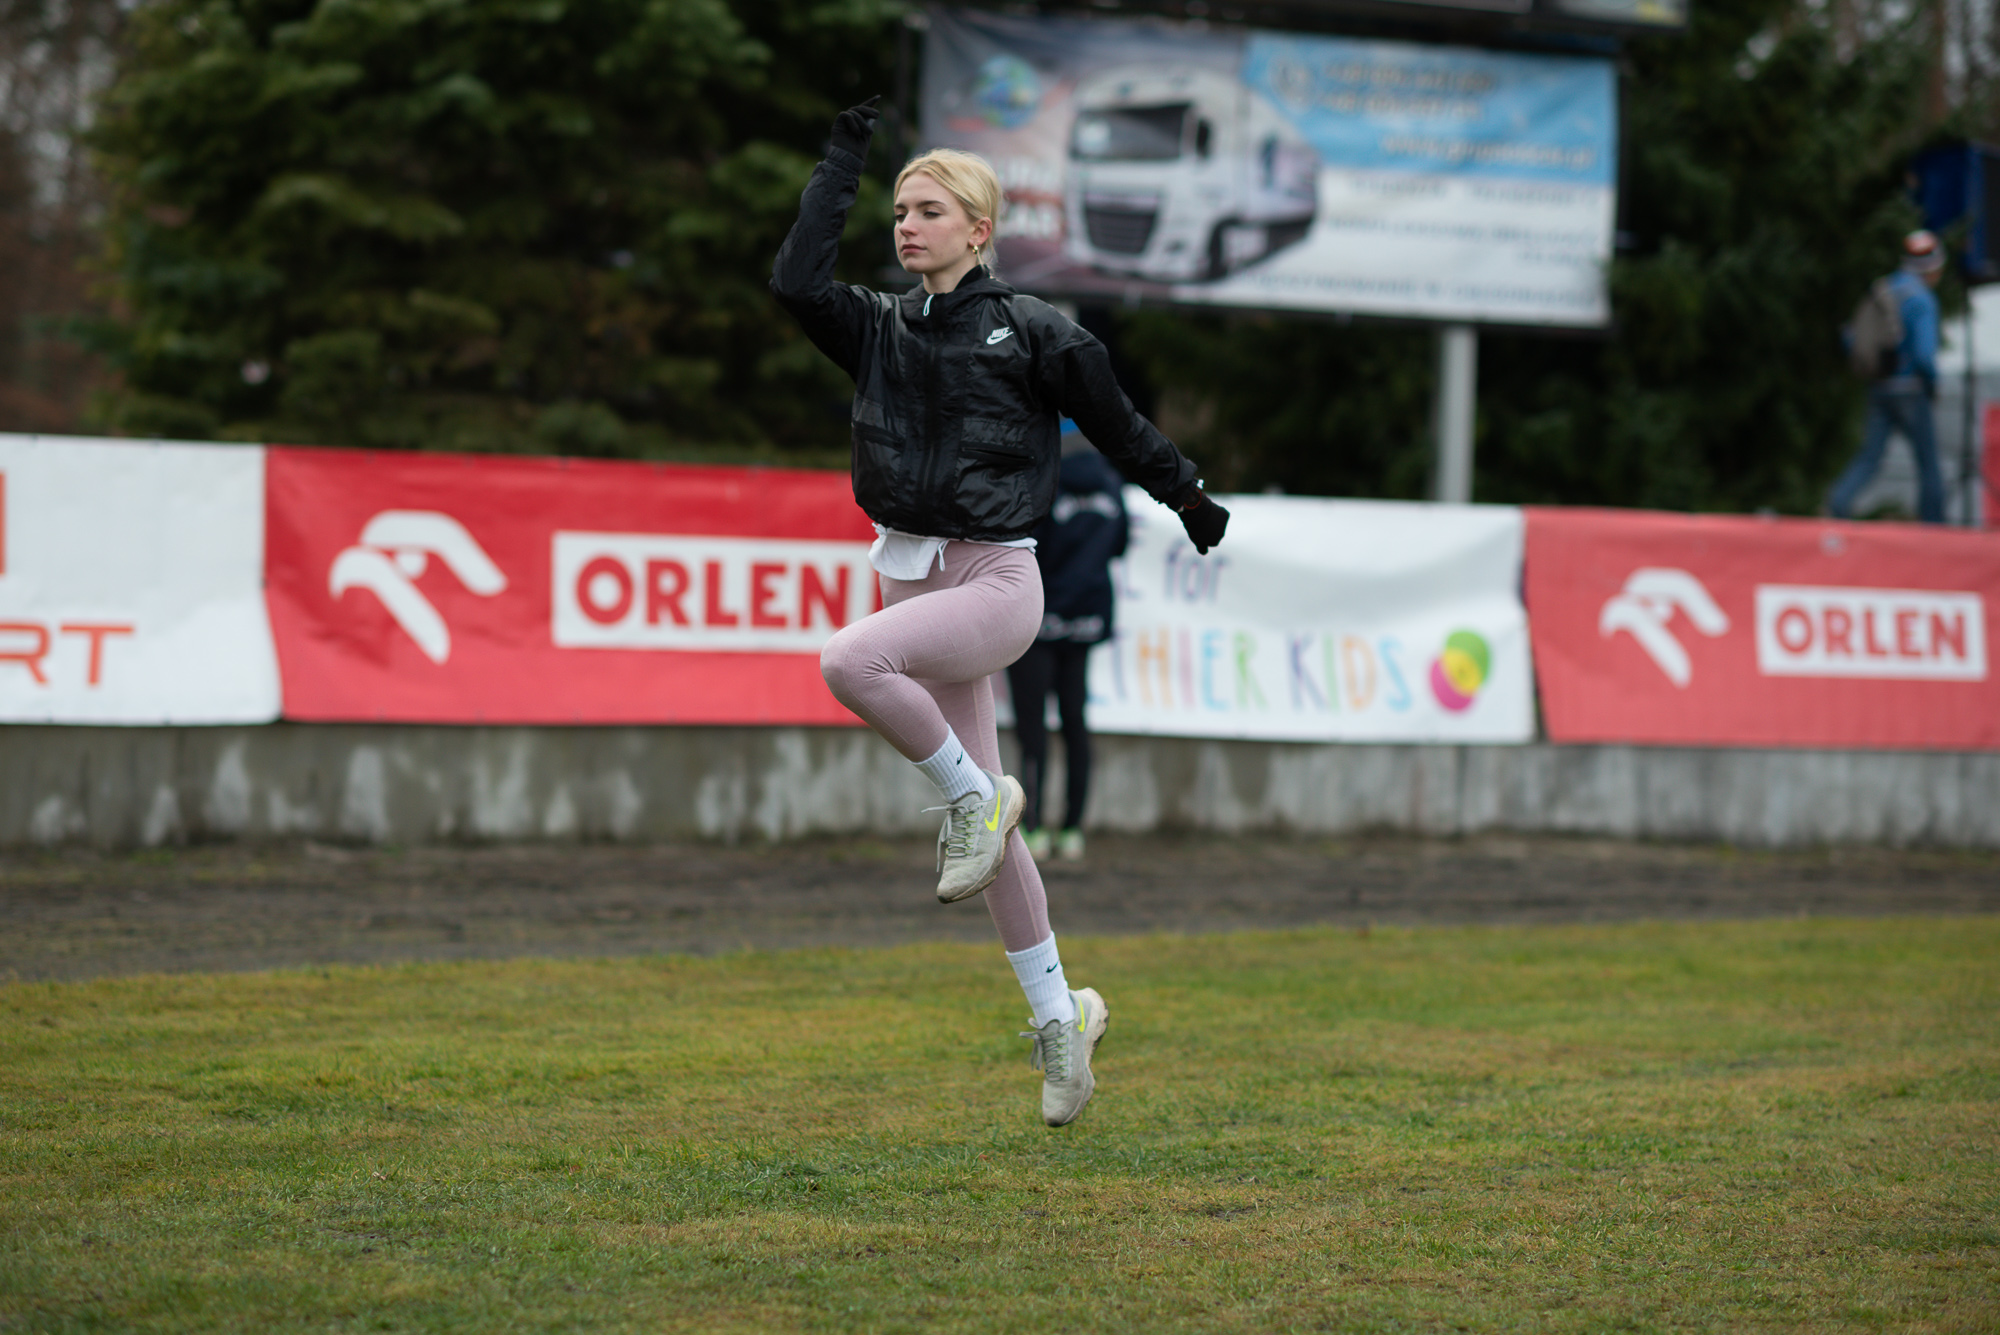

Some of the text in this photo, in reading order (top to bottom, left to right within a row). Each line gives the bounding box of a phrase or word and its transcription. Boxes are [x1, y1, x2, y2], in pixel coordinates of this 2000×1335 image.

[575, 555, 850, 630] ORLEN
[1163, 536, 1231, 605] for
[1774, 606, 1968, 662] ORLEN
[1090, 626, 1414, 715] THIER KIDS
